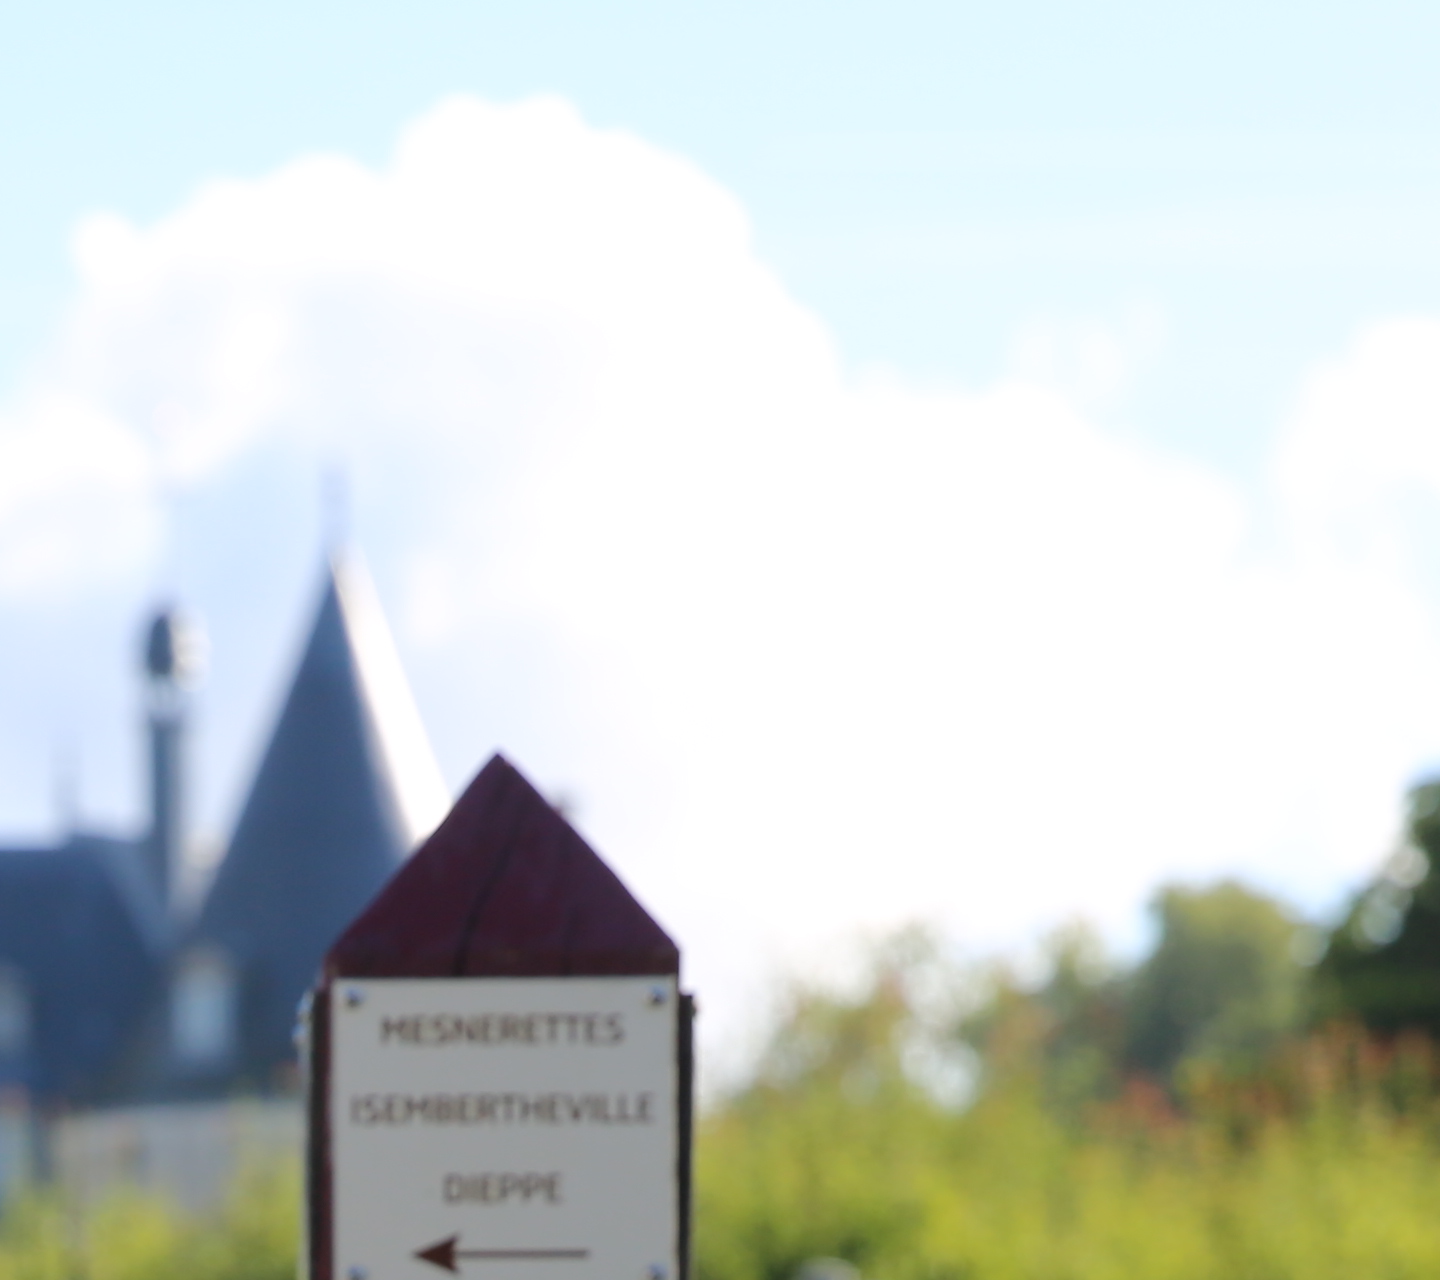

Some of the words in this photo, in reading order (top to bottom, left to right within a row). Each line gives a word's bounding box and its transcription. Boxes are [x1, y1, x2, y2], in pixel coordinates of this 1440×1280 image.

[381, 1013, 625, 1045] MESNERETTES
[351, 1092, 655, 1125] ISEMBERTHEVILLE
[443, 1173, 563, 1204] DIEPPE
